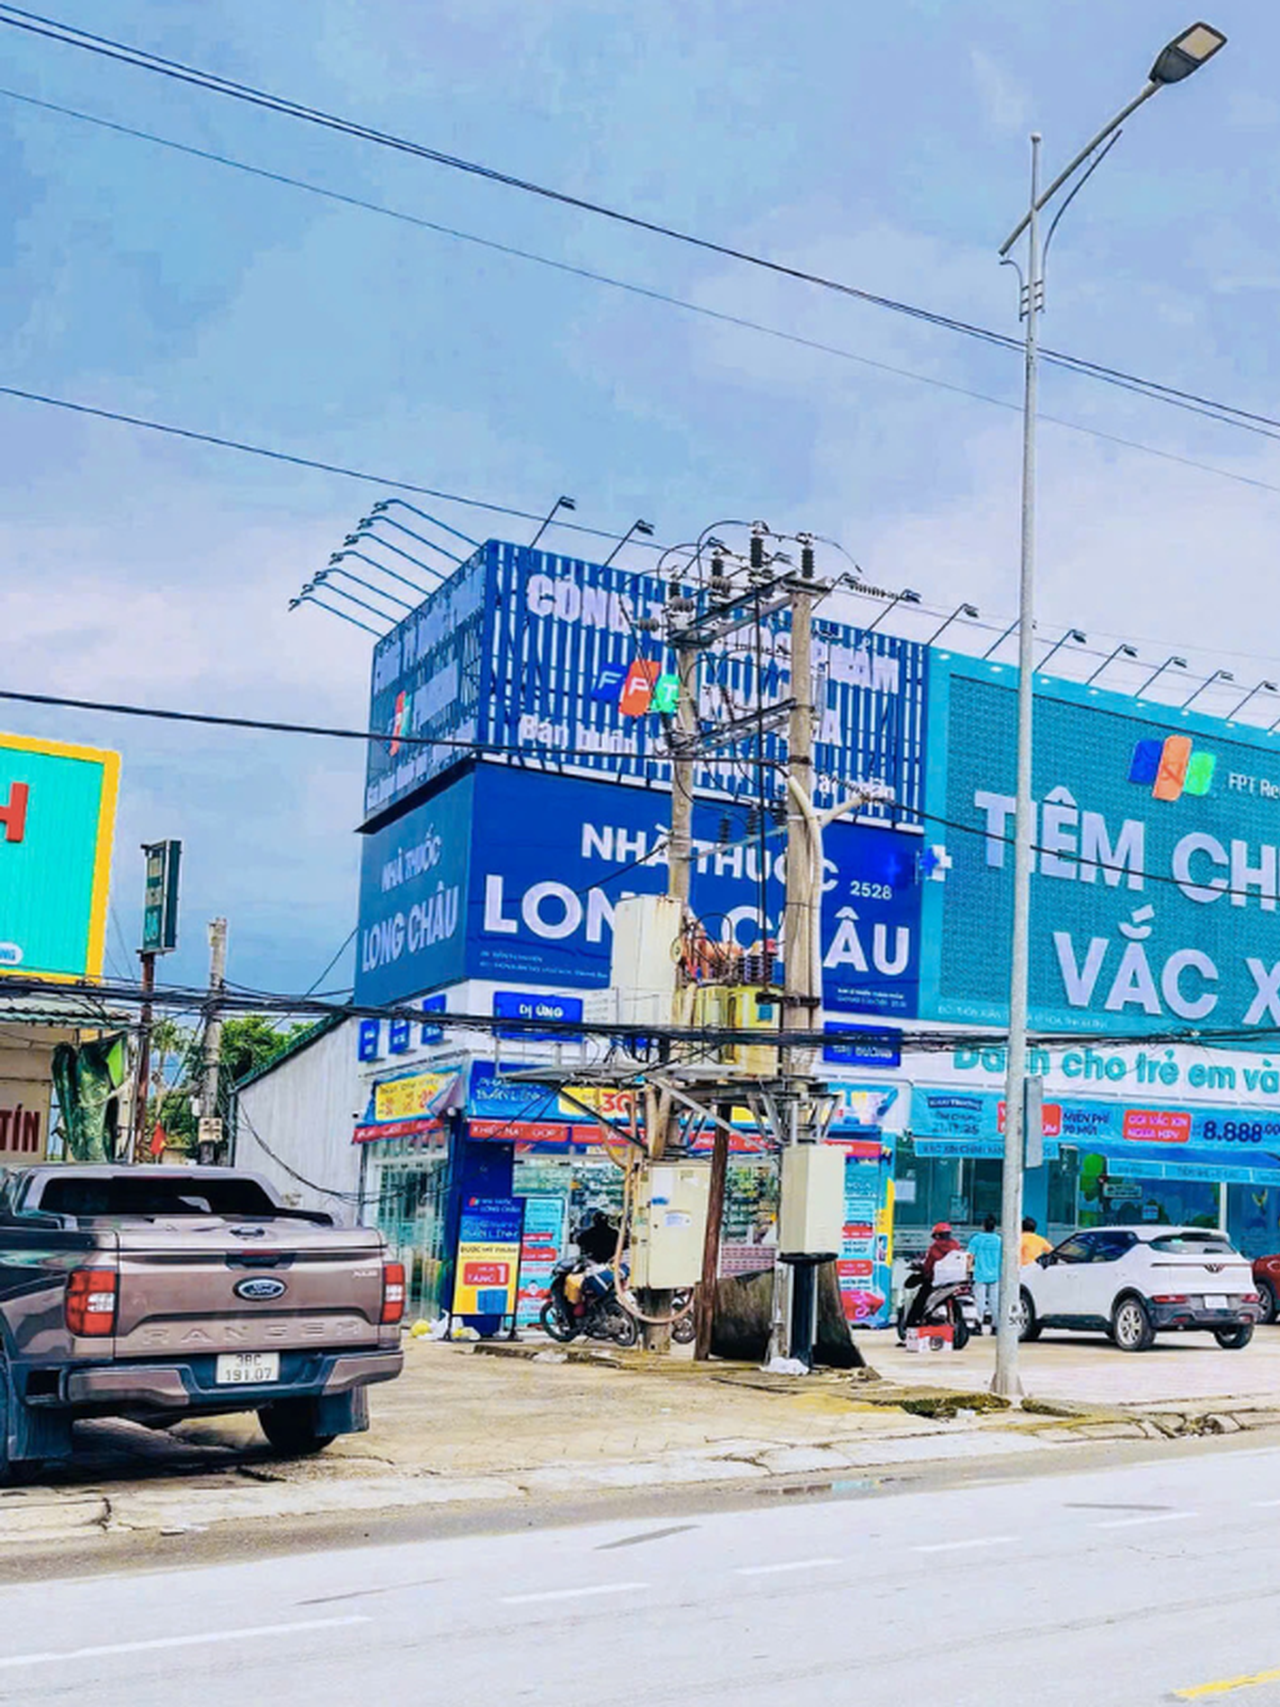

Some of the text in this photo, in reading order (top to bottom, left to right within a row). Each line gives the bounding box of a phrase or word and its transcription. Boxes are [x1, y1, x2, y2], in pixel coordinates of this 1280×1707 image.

[599, 670, 677, 703] FPT
[1228, 772, 1255, 794] FPT
[850, 879, 893, 900] 2528
[361, 880, 460, 973] LONG CHÂU
[721, 905, 910, 976] CÂU
[1053, 904, 1220, 1020] VẮC
[1062, 1046, 1127, 1082] cho
[1136, 1050, 1179, 1086] trẻ
[1188, 1062, 1236, 1091] em
[1243, 1059, 1280, 1095] và
[0, 1102, 41, 1152] TÍN
